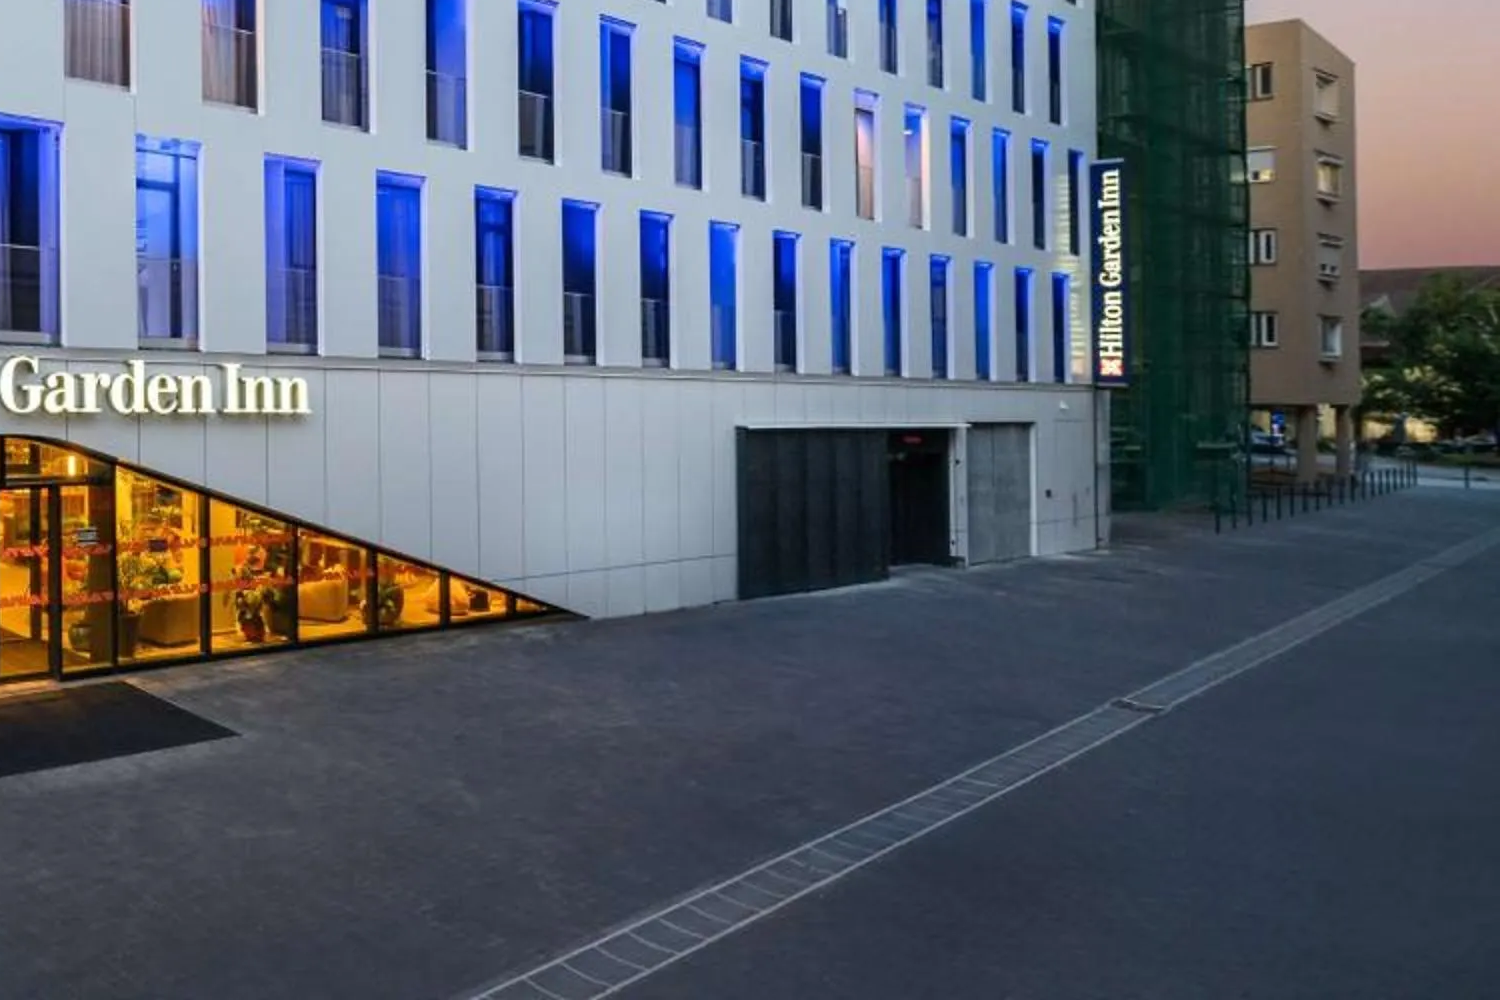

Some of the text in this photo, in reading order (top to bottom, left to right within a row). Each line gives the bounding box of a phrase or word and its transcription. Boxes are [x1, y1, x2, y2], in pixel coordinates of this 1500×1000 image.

[1098, 168, 1122, 357] Hilton Garden Inn
[0, 355, 216, 414] Garden
[221, 362, 312, 414] Inn
